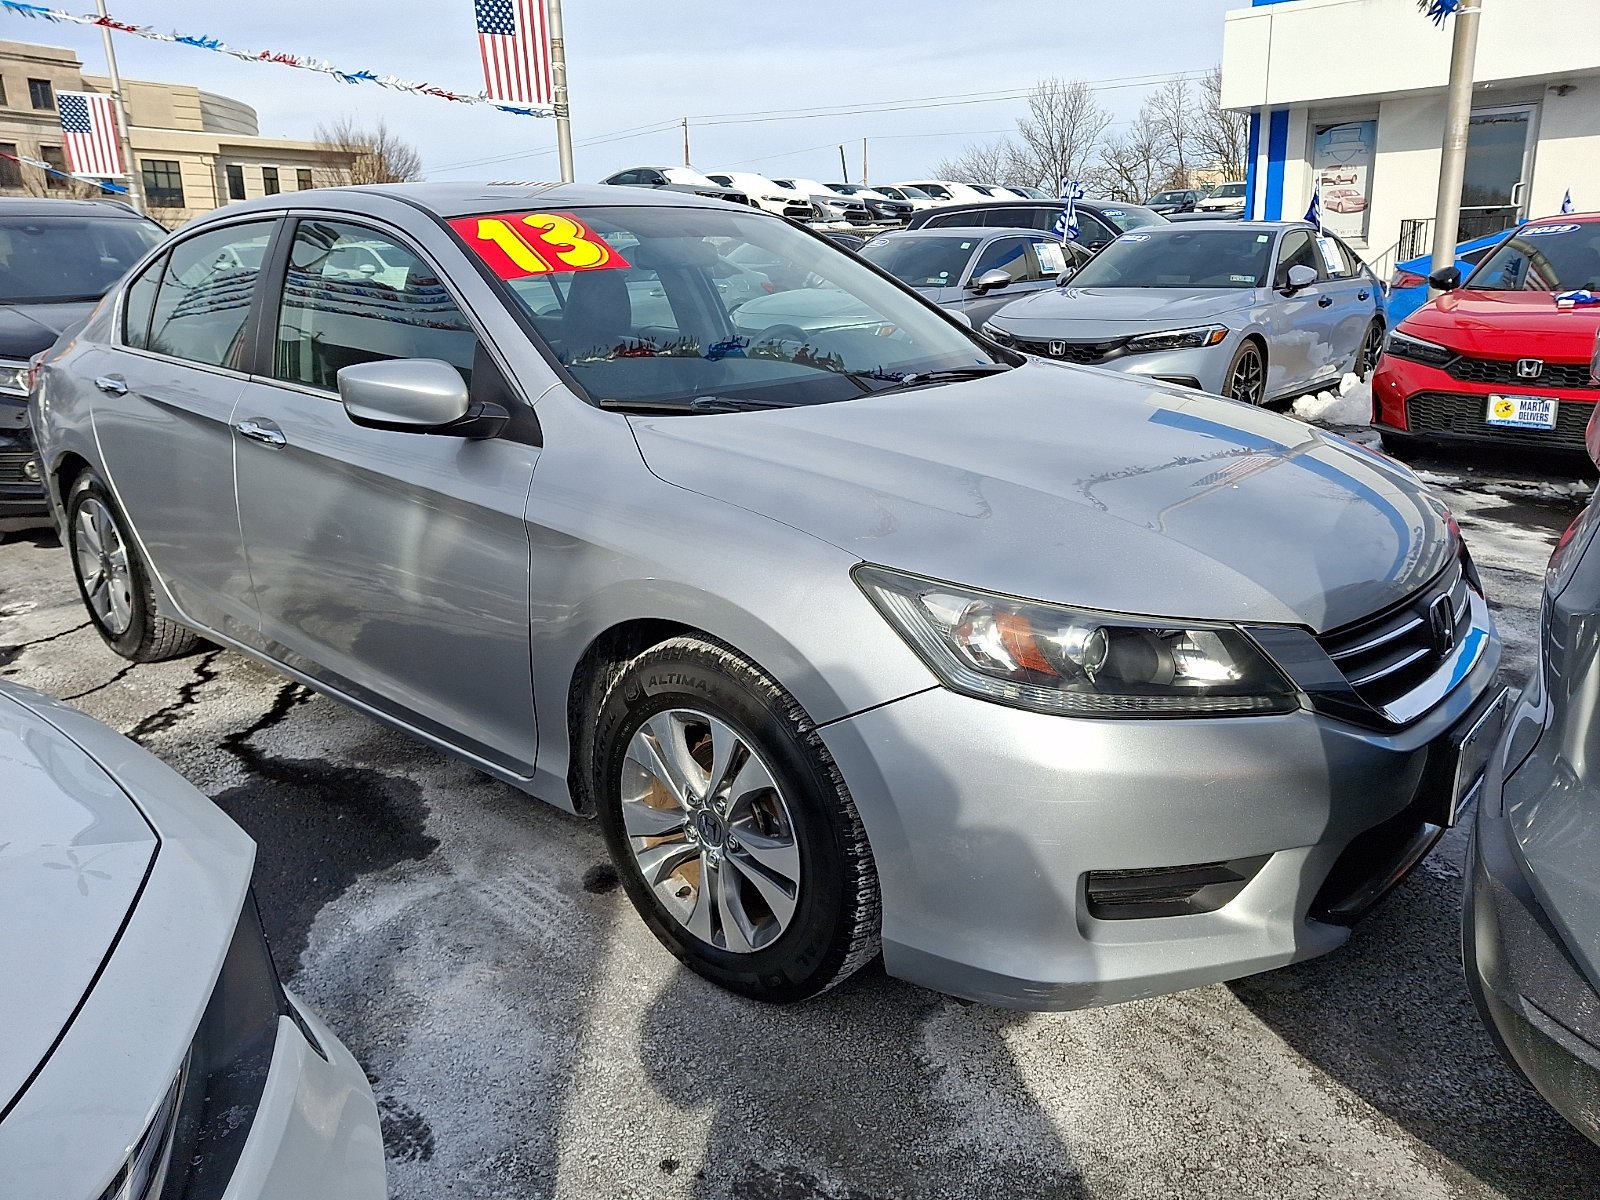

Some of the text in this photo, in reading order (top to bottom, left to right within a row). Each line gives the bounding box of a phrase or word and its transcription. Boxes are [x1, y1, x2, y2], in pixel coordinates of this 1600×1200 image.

[476, 213, 610, 273] 13
[1520, 400, 1551, 413] MARTIN
[1518, 411, 1550, 423] DELIVERS
